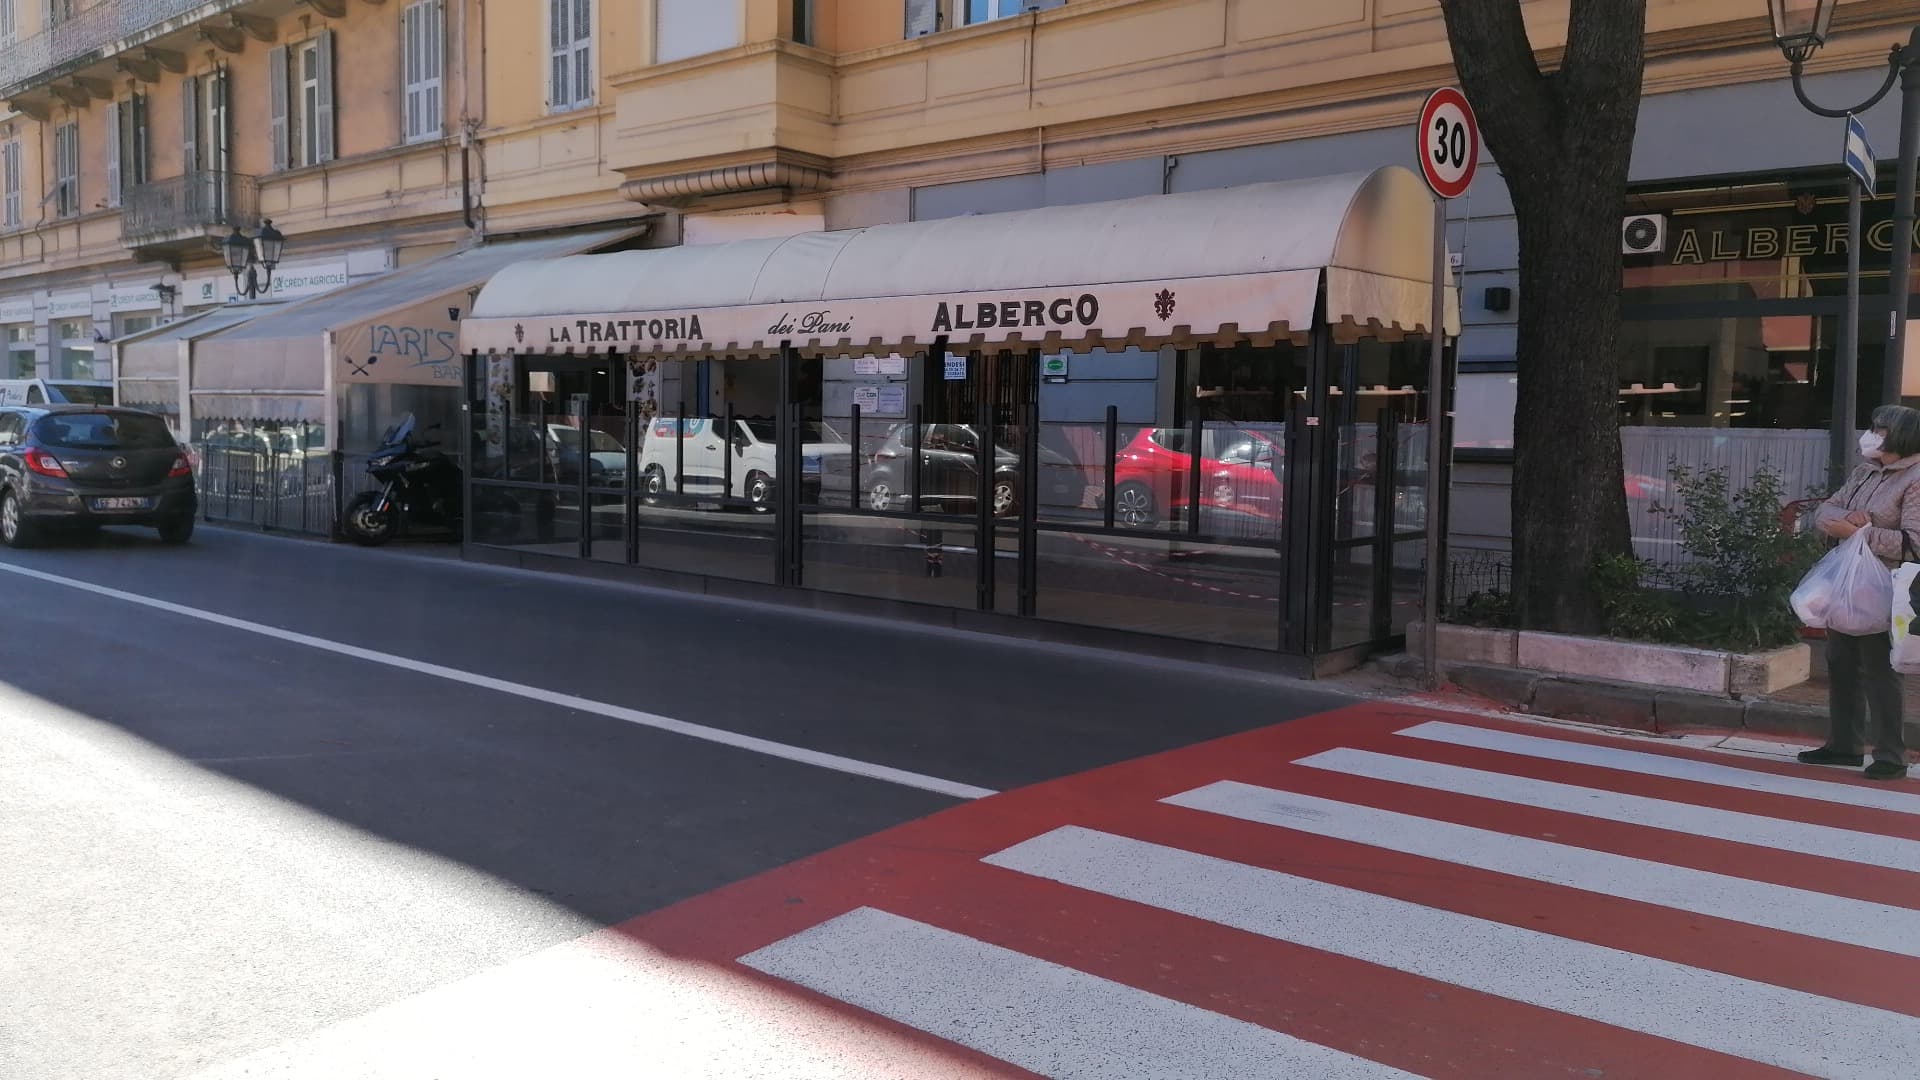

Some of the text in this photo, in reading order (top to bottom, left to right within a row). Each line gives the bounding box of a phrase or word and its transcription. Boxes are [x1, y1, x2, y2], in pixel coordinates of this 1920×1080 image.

[1434, 116, 1466, 169] 30
[1671, 218, 1920, 265] ALBERG
[309, 273, 345, 287] AGRICOLE
[550, 293, 1099, 343] LA TRATTORIA dei Pani ALBERGO
[432, 365, 463, 380] BAR
